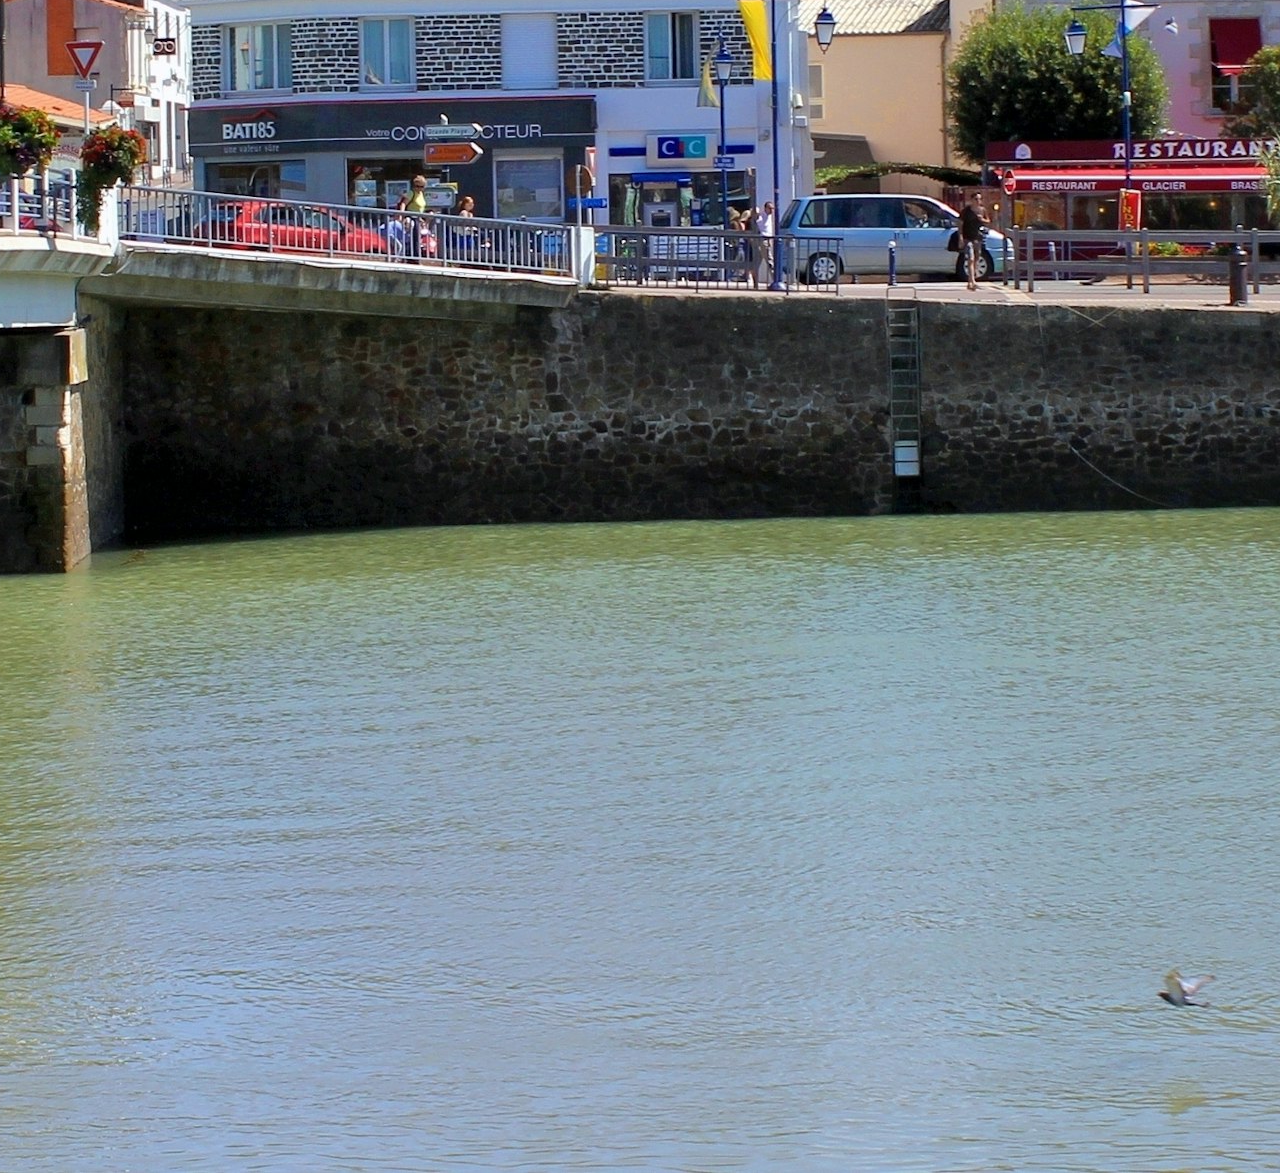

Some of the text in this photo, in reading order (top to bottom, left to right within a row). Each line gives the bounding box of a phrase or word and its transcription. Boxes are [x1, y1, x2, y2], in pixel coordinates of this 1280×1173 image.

[222, 121, 276, 139] BATI85
[365, 129, 390, 137] Votre
[239, 145, 261, 153] valeur
[1032, 182, 1097, 190] RESTAURANT
[1142, 181, 1186, 190] GLACIER
